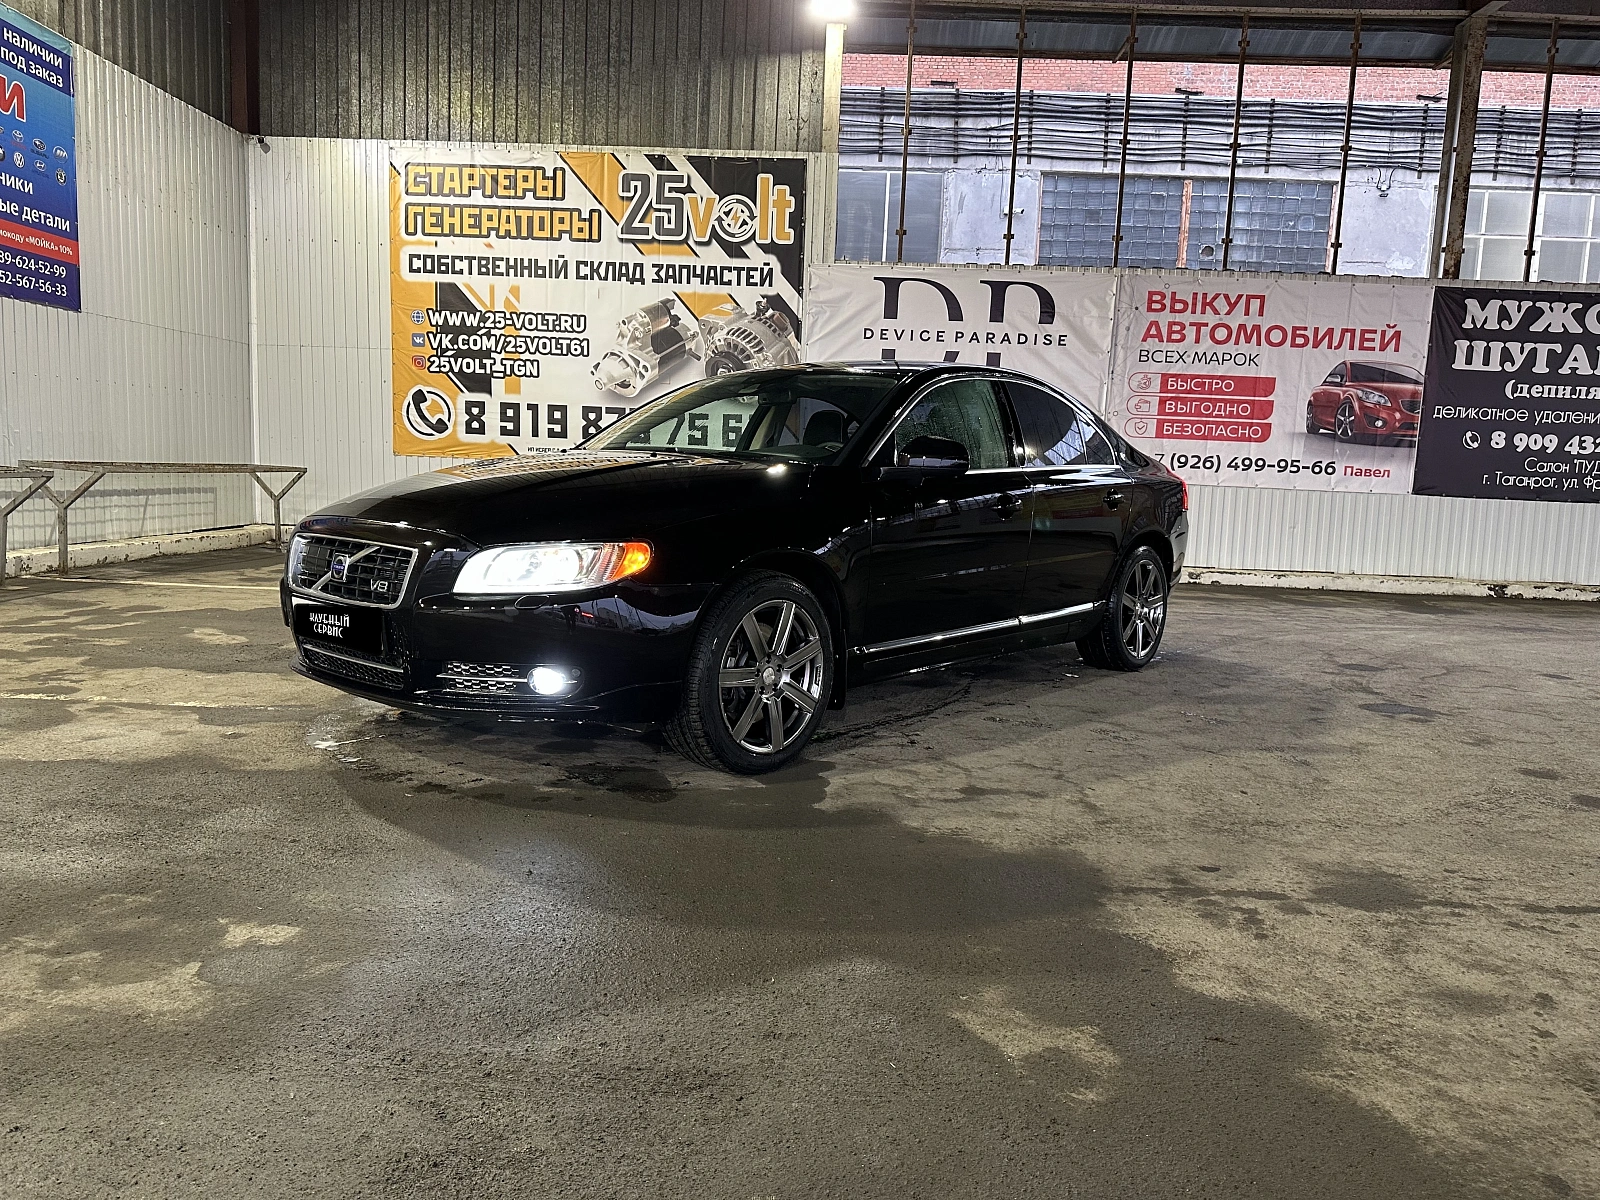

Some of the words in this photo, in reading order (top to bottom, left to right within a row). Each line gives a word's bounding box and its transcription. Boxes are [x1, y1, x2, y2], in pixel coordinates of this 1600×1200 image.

[3, 27, 63, 69] наличии
[0, 46, 27, 73] под
[29, 61, 63, 88] заказ
[405, 163, 566, 200] СТАРТЕРЫ
[22, 205, 70, 232] детали
[405, 203, 602, 242] ГЕНЕРАТОРЫ
[408, 252, 568, 280] СОБСТВЕННЫЙ
[575, 260, 645, 285] СКЛАД
[651, 261, 774, 288] ЗАПЧАСТЕЙ
[1146, 290, 1266, 317] ВЫКУП
[427, 308, 587, 333] WWW.25-VOLT.RU
[427, 332, 590, 357] VK.COM/25VOLT61
[863, 327, 945, 343] DEVICE
[954, 331, 1068, 347] PARADISE
[1141, 320, 1402, 353] АВТОМОБИЛЕЙ
[427, 356, 540, 379] 25VOLT_TGN
[1138, 349, 1188, 364] ВСЕХ
[1191, 351, 1260, 367] МАРОК
[1451, 339, 1600, 375] ШУГА
[1167, 378, 1235, 392] БЫСТРО
[464, 401, 486, 436] 8
[499, 402, 569, 440] 919
[1165, 401, 1251, 417] ВЫГОДНО
[1433, 405, 1529, 422] деликатное
[1163, 422, 1262, 438] БЕЗОПАСНО
[1490, 430, 1506, 449] 8
[1513, 433, 1559, 454] 909
[1169, 452, 1222, 473] (926)
[1227, 456, 1337, 476] 499-95-66
[1343, 465, 1391, 479] Павел
[1524, 457, 1570, 473] Салон
[1495, 471, 1558, 490] Таганрог,
[1562, 478, 1579, 491] ул.
[370, 578, 389, 592] V8
[309, 612, 350, 628] КЛУБНЫЙ
[313, 622, 343, 639] СЕРВИС
